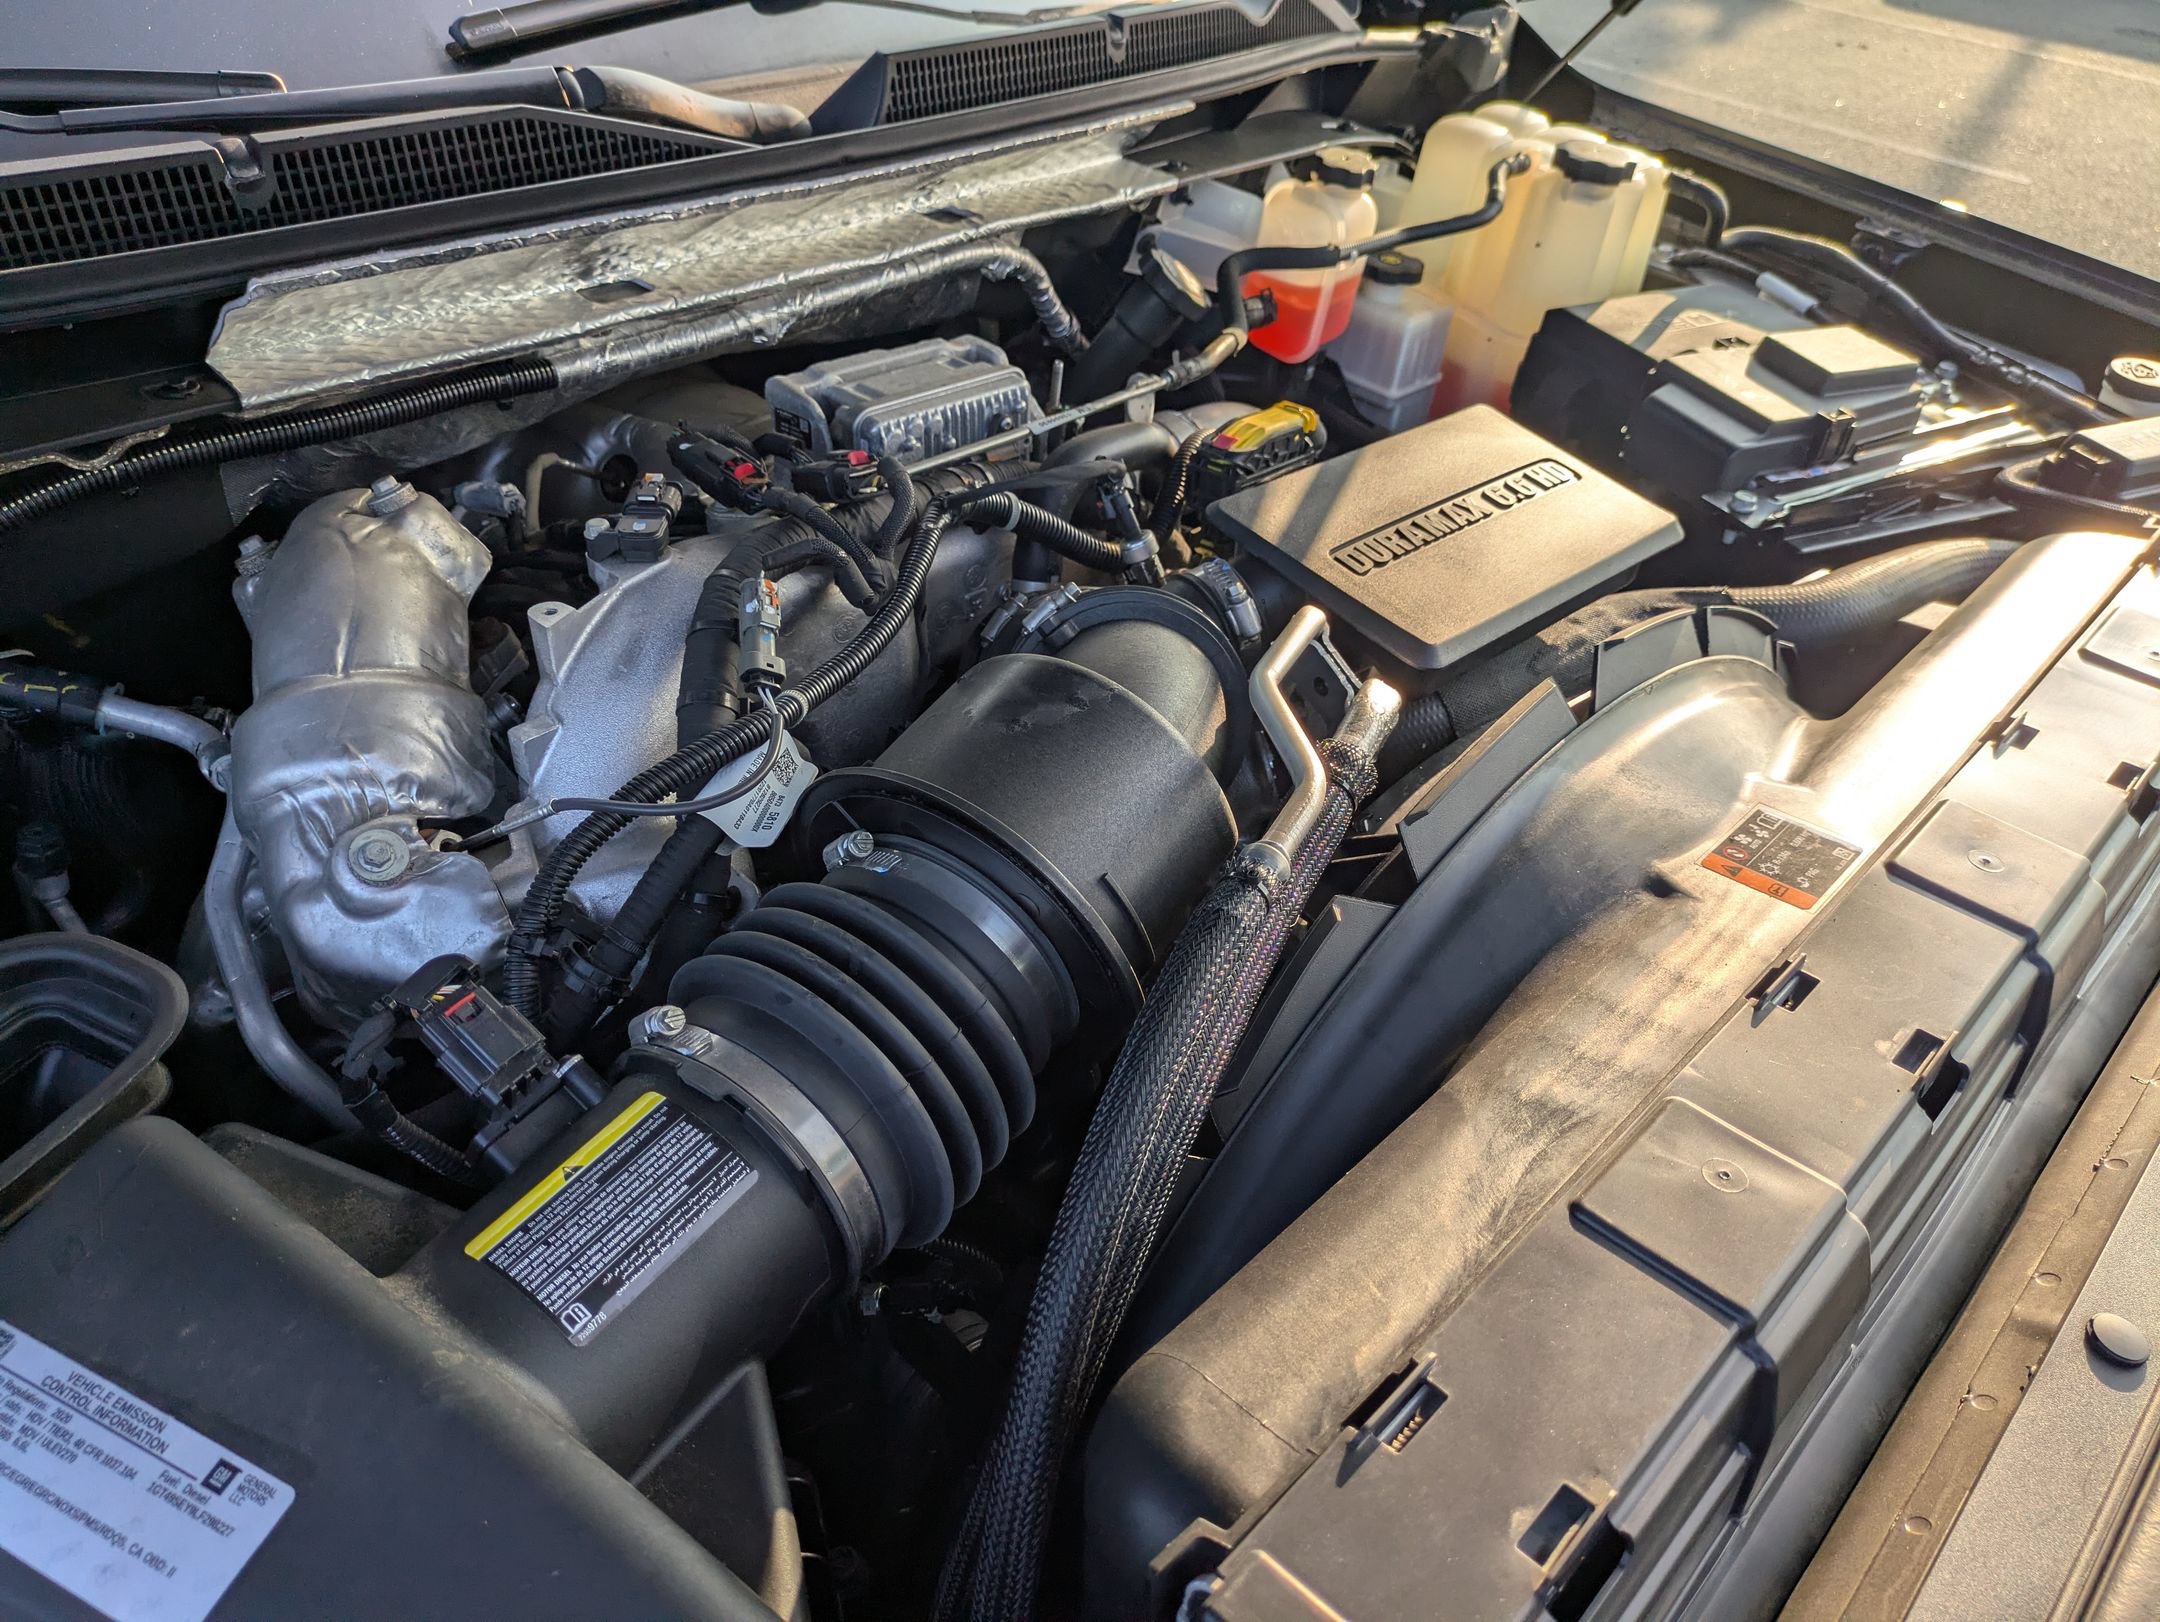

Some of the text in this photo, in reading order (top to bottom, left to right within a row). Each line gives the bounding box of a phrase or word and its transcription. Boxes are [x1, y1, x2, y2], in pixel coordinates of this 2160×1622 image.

[1334, 463, 1572, 575] DURAMAX 6.6 HD
[745, 750, 766, 776] MADE IN
[761, 811, 780, 831] 5810
[531, 1229, 545, 1241] Plug
[508, 1257, 531, 1277] MOTEUR
[527, 1242, 547, 1260] DIESEL
[535, 1282, 556, 1301] MOTOR
[552, 1267, 573, 1285] DIESEL
[577, 1253, 589, 1264] use
[39, 1374, 171, 1455] CONTROL INFORMATION
[66, 1370, 168, 1434] VEHICLE EMISSION
[49, 1405, 74, 1425] 2020
[81, 1441, 104, 1461] CFR
[157, 1467, 212, 1506] Fuel: Diesel
[234, 1482, 269, 1506] MOTORS
[242, 1473, 278, 1498] GENERAL
[227, 1491, 246, 1507] LLC
[126, 1541, 146, 1559] CA
